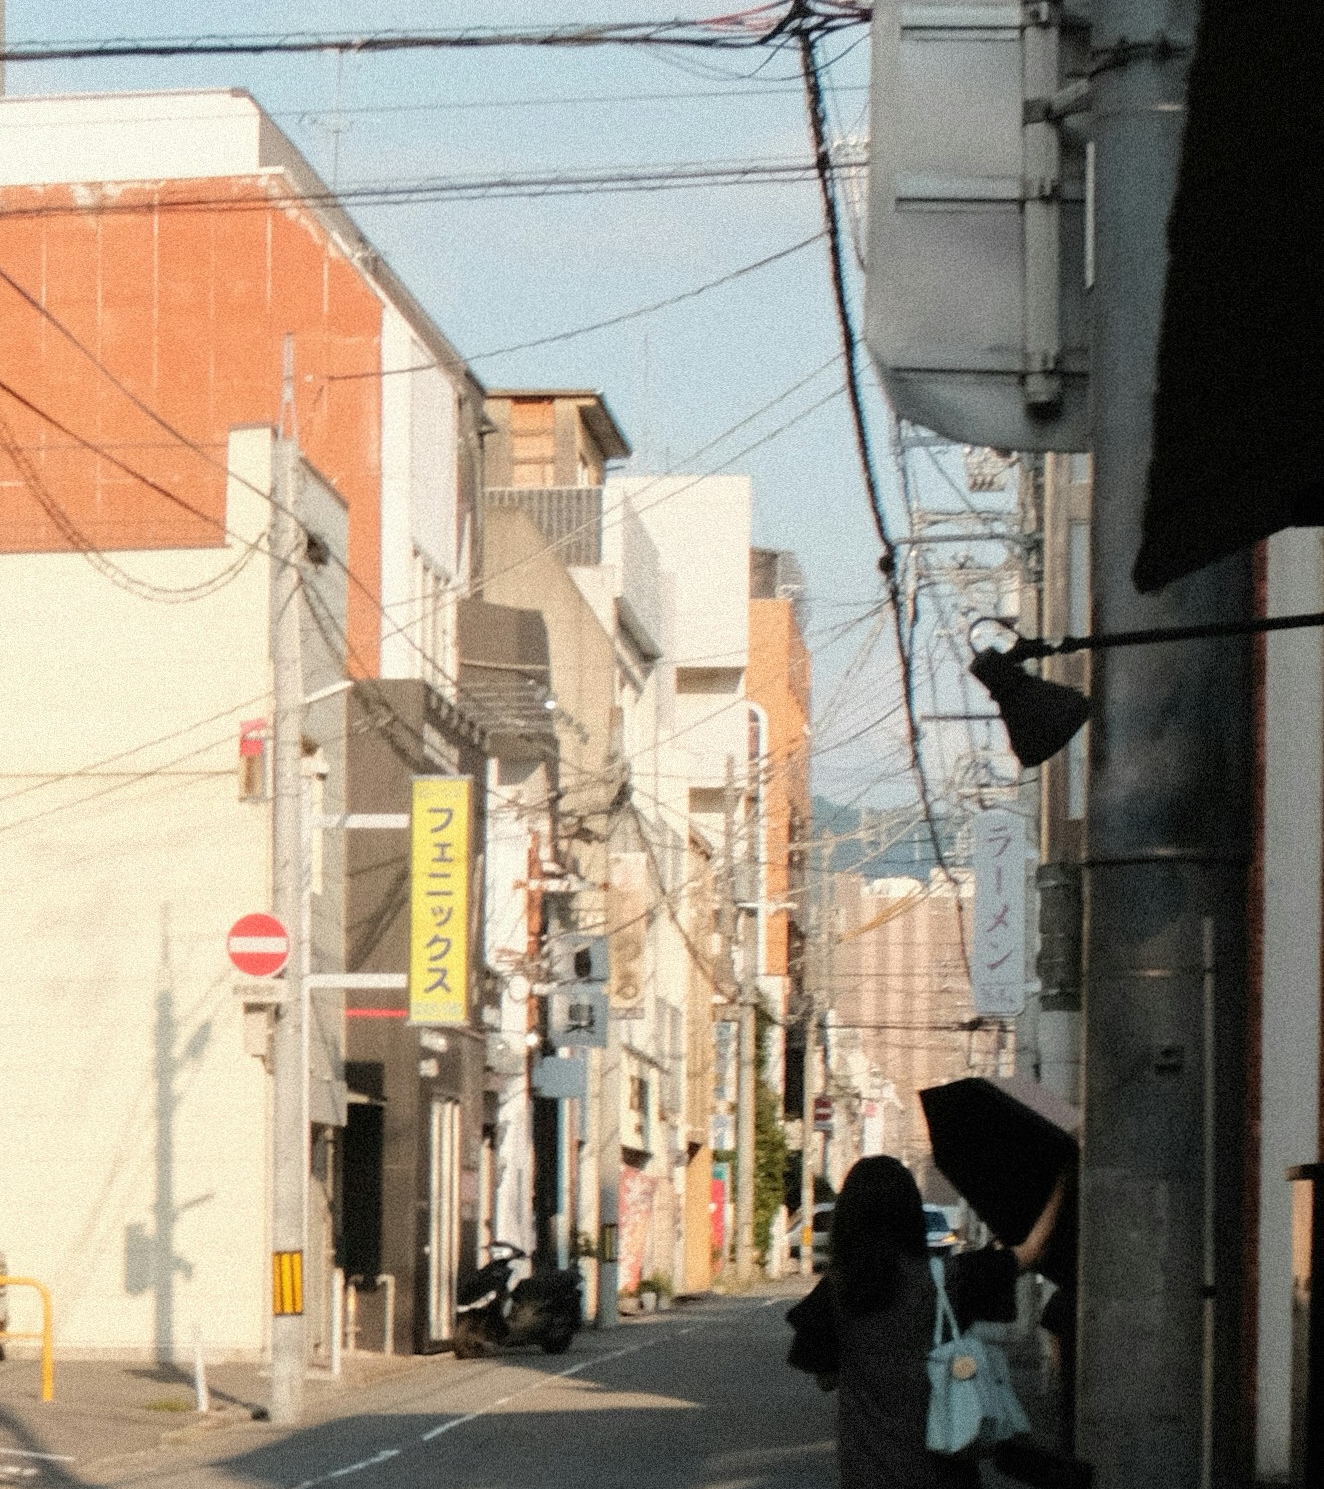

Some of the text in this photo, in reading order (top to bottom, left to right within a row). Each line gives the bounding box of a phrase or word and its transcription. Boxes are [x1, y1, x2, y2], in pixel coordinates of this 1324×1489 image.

[425, 807, 455, 993] フェニックス
